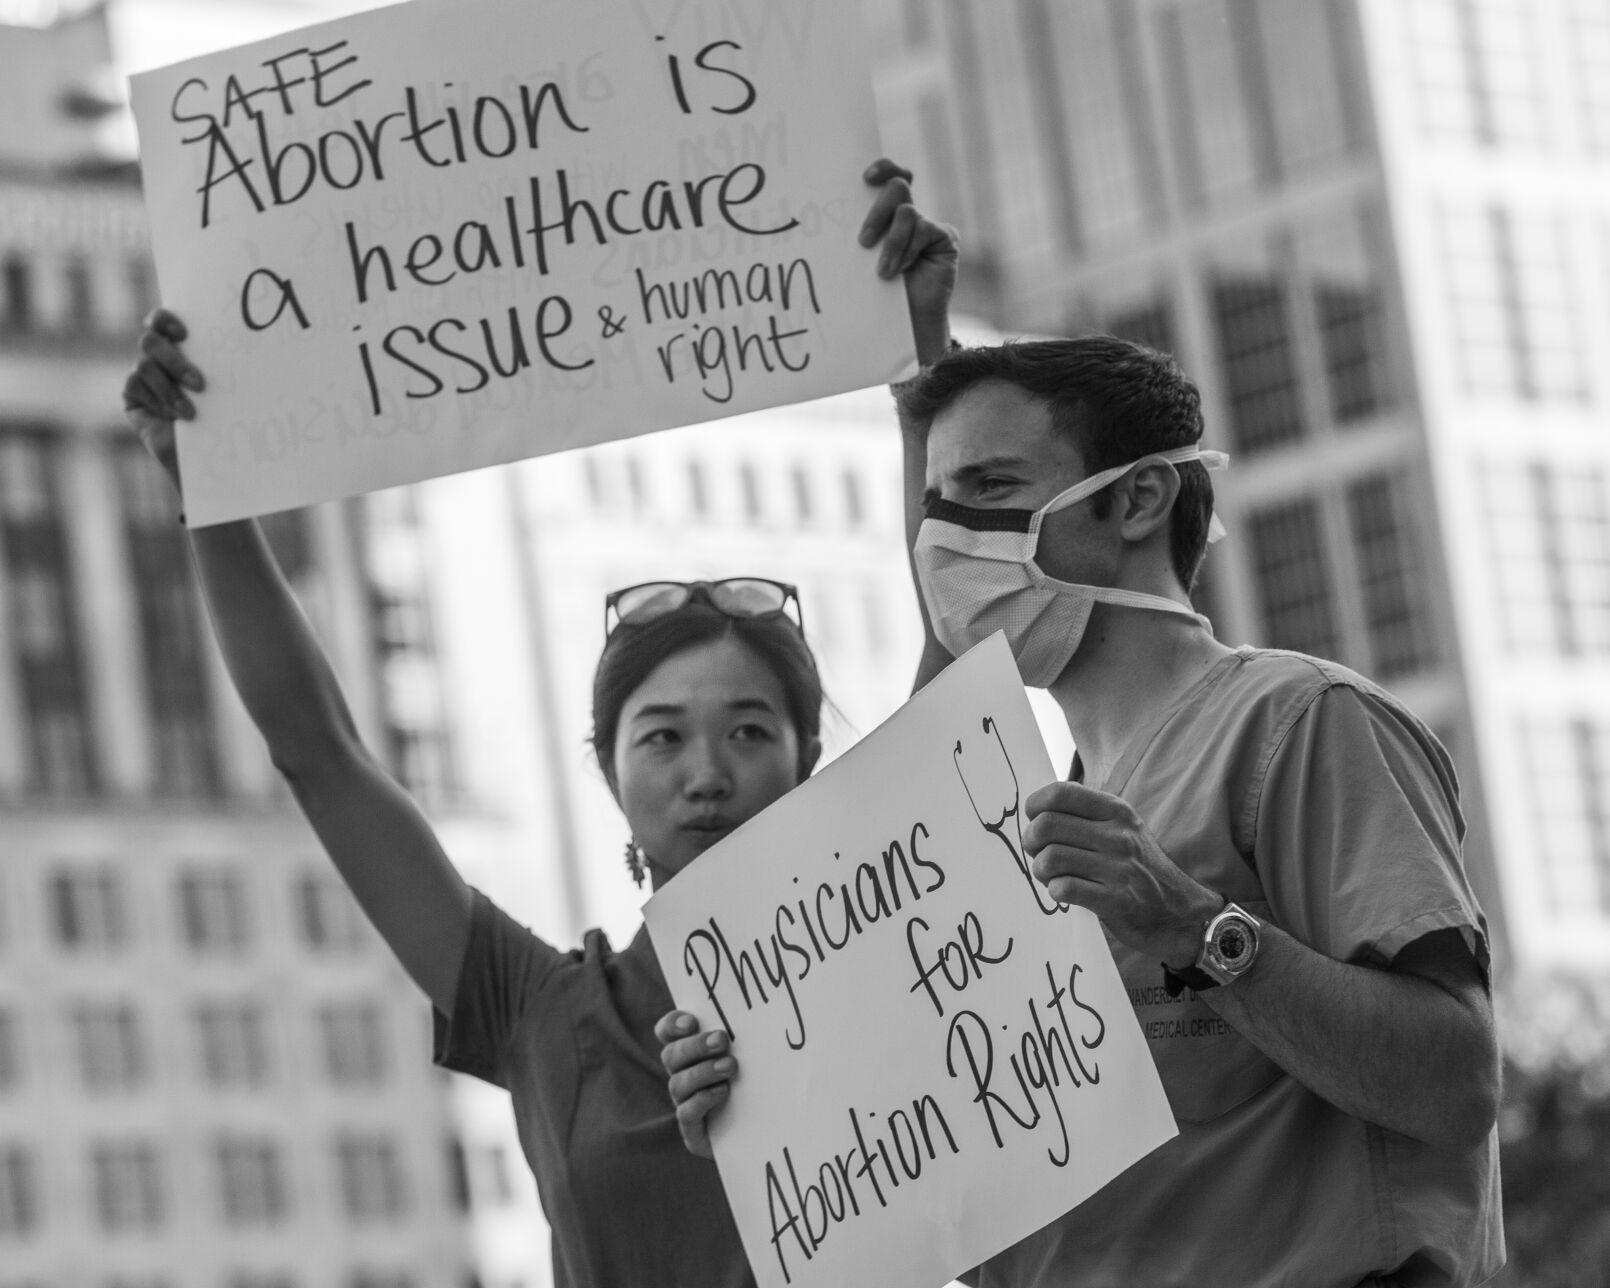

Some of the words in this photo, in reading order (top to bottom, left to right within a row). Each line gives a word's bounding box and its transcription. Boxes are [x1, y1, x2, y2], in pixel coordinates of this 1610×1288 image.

[170, 38, 373, 145] SAFE
[193, 82, 589, 229] Abortion
[654, 35, 758, 117] is
[240, 267, 311, 332] a
[345, 162, 801, 304] healthcare
[352, 295, 597, 417] issue
[597, 304, 627, 340] &
[634, 258, 823, 326] human
[656, 315, 812, 403] right
[683, 821, 946, 1051] Physicians
[1145, 1020, 1189, 1039] MEDICAL
[1190, 1017, 1232, 1038] CENTER
[764, 1094, 960, 1285] Abortion
[945, 960, 1106, 1168] Rights
